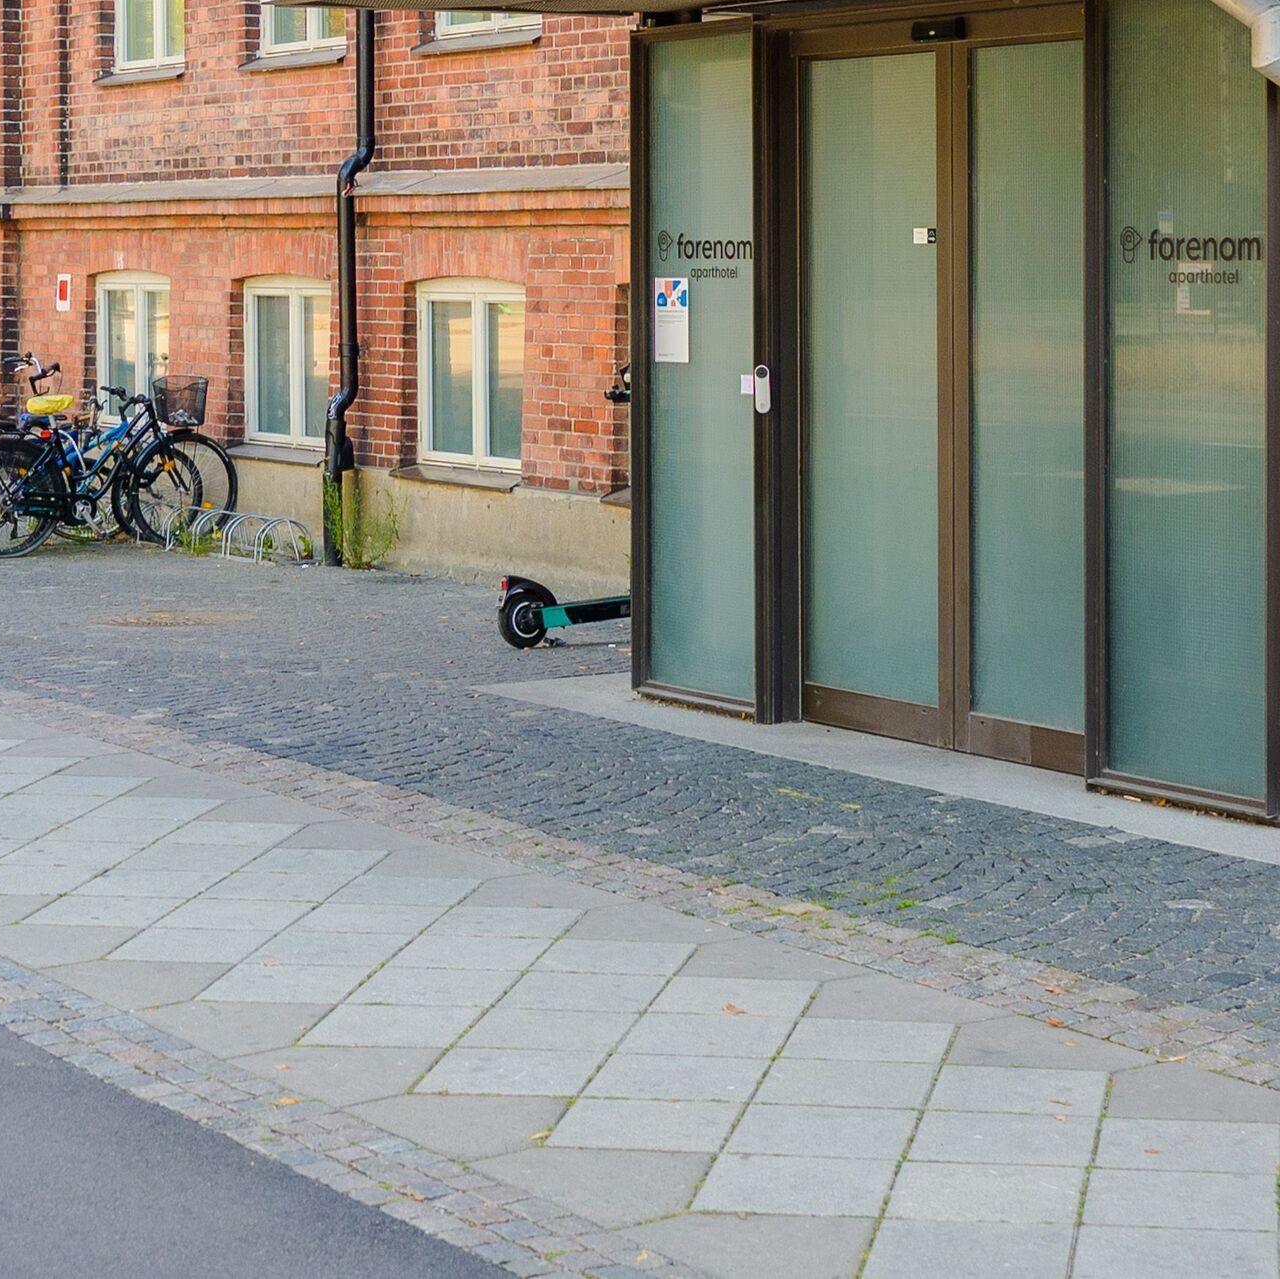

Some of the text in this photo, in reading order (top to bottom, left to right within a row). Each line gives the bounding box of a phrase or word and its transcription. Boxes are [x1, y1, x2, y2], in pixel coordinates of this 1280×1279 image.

[676, 232, 753, 260] forenom
[1148, 228, 1262, 261] forenom
[690, 266, 738, 281] aparthotel
[1168, 269, 1239, 287] aparthotel
